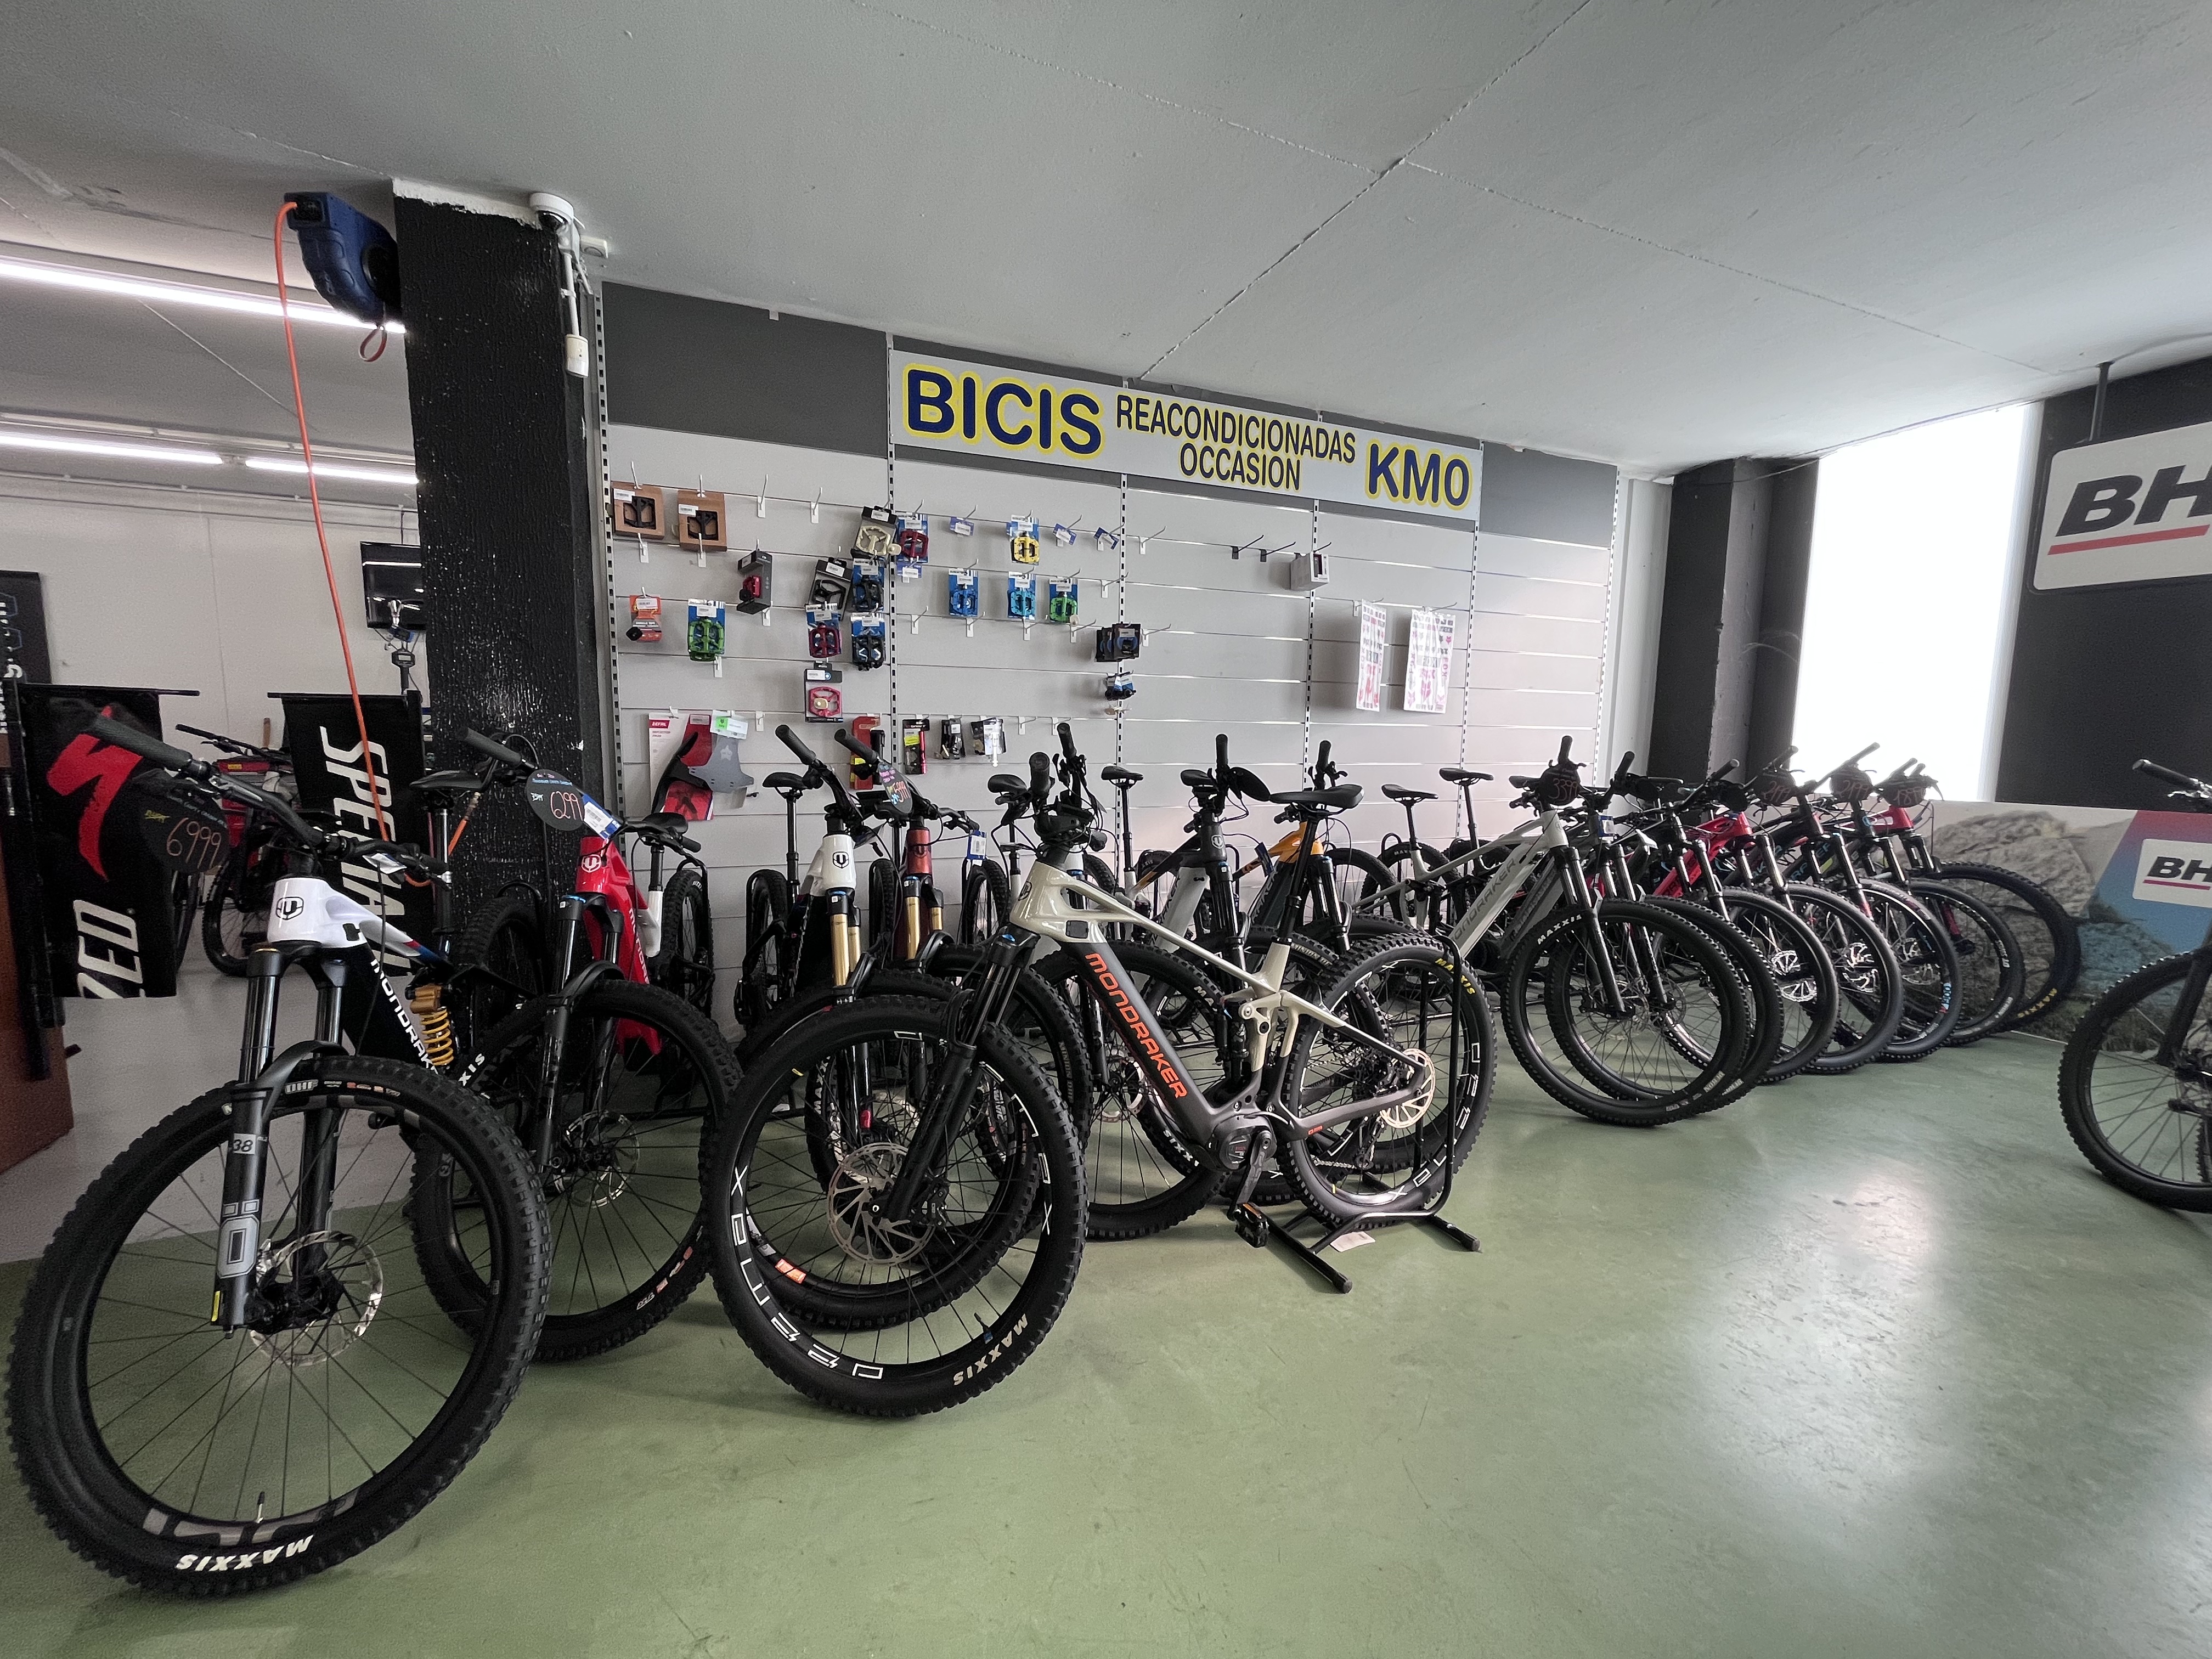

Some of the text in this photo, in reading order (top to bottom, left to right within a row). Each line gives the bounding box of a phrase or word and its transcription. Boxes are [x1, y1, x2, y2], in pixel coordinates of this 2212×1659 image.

[907, 369, 1101, 454] BICIS
[1116, 394, 1356, 464] REACONDICIONADAS
[1180, 442, 1301, 492] OCCASION
[2056, 465, 2212, 537] BH
[1548, 777, 1578, 802] 3399
[166, 817, 222, 871] 6999
[2147, 856, 2212, 883] BH
[1452, 857, 1518, 943] ONDRAKER
[1085, 952, 1188, 1099] MONDRAKER
[233, 1139, 254, 1152] 38
[953, 1312, 1028, 1387] MAXXIS
[174, 1534, 314, 1572] MAXXIS
